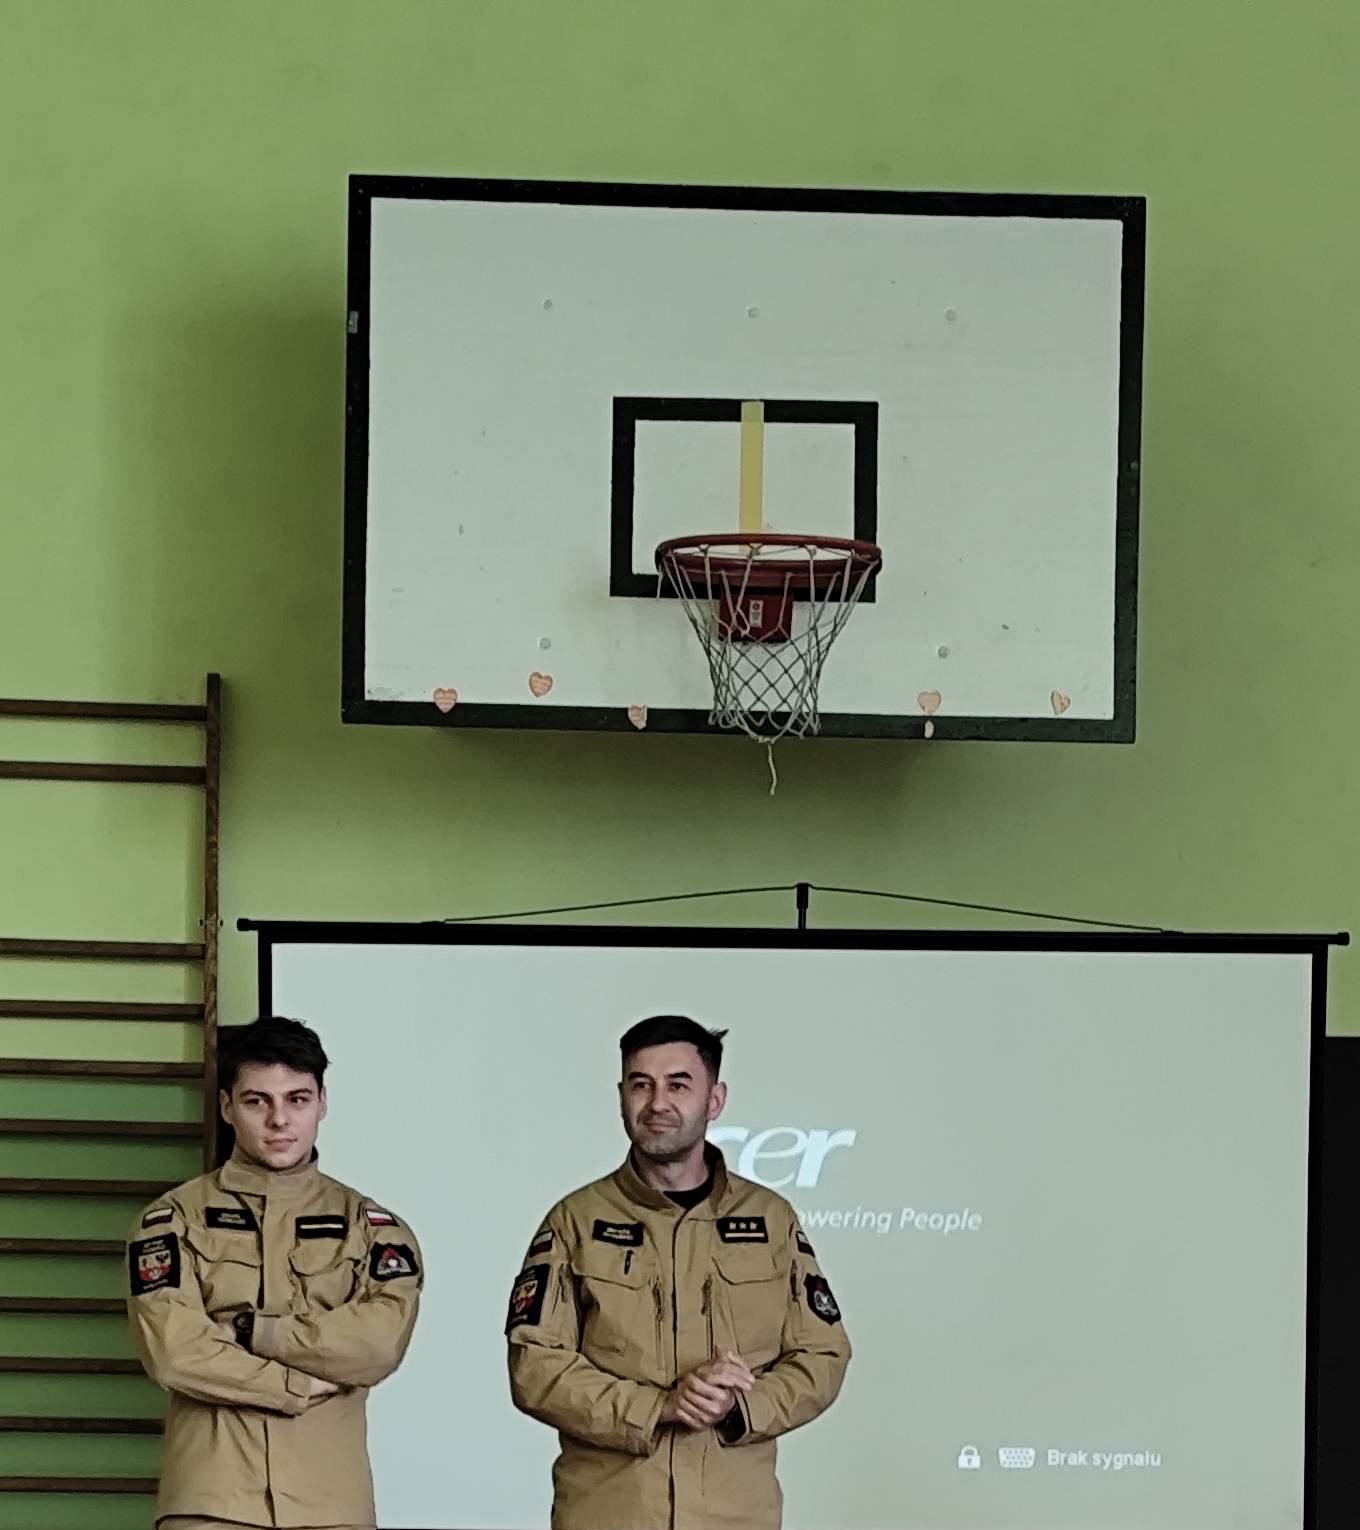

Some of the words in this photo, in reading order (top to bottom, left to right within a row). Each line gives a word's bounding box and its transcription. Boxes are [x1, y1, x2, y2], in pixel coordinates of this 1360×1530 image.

[707, 1126, 857, 1188] er
[899, 1207, 983, 1235] People
[1047, 1448, 1087, 1467] Brak
